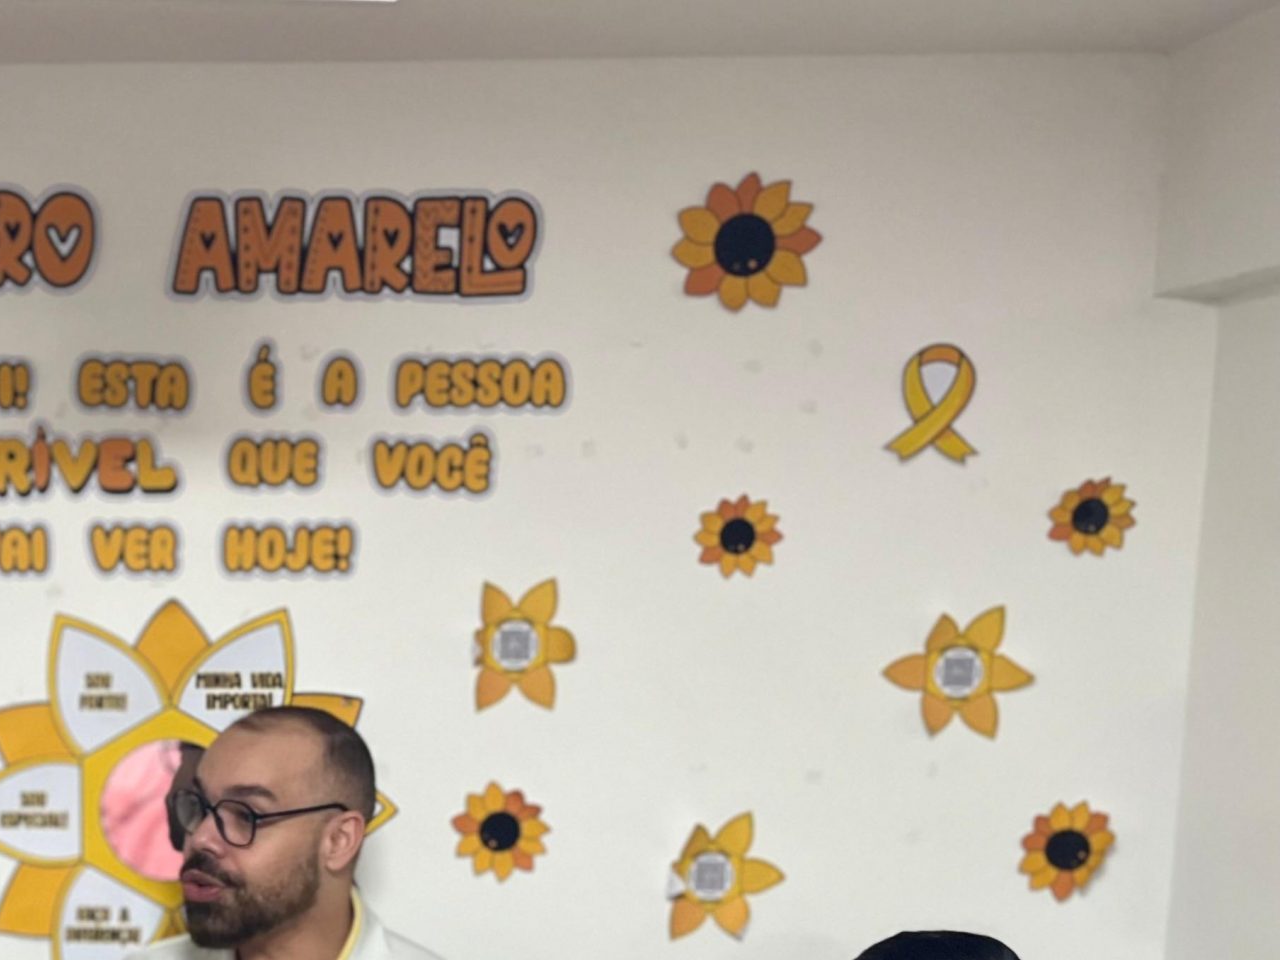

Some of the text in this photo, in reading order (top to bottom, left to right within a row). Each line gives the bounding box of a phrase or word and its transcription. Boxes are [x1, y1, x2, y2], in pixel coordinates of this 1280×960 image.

[173, 197, 537, 297] AMARELO
[78, 359, 189, 410] ESTA
[249, 343, 277, 409] É
[323, 357, 358, 408] A
[396, 358, 566, 408] PESSOA
[228, 438, 319, 488] QUE
[372, 432, 493, 492] VOCÊ
[91, 525, 177, 573] VER
[224, 524, 354, 574] HOJE!
[195, 672, 283, 689] MINHA VIDA
